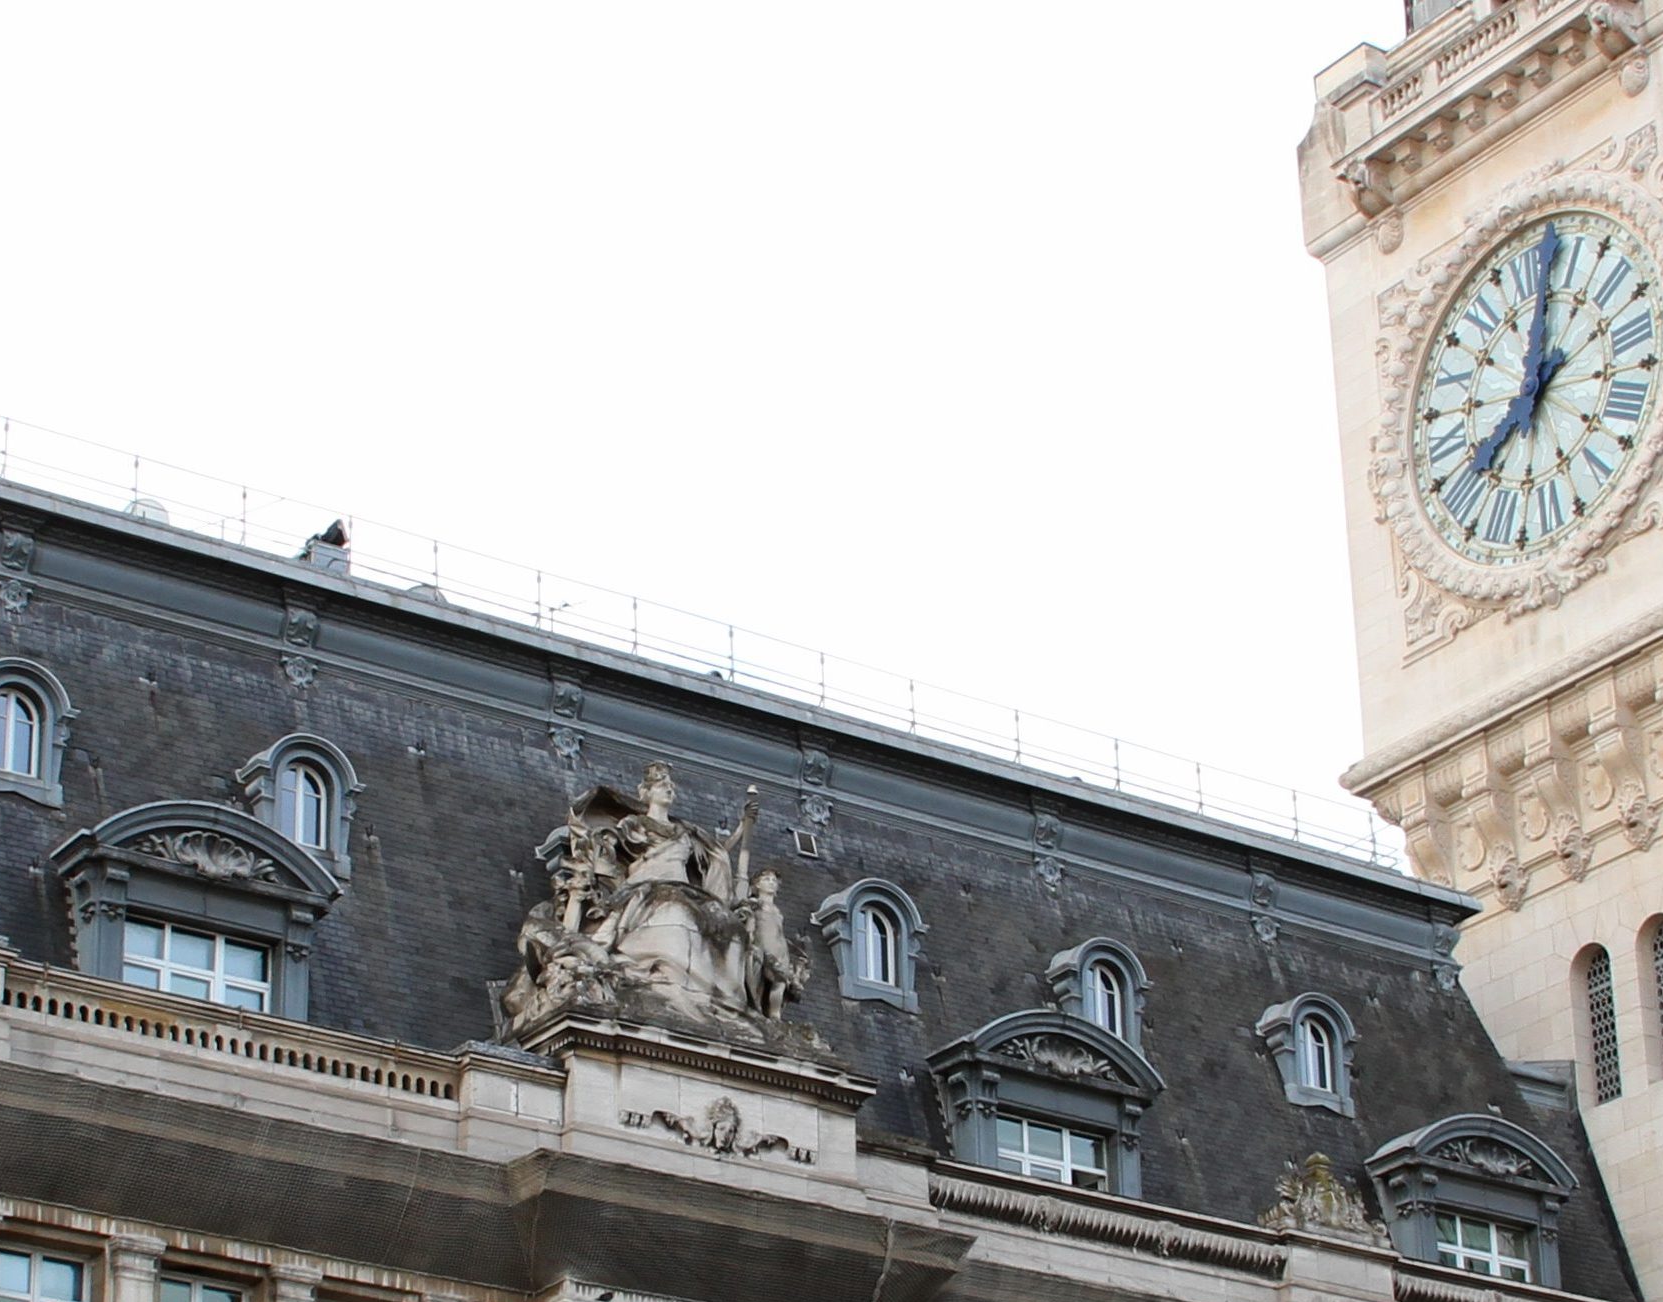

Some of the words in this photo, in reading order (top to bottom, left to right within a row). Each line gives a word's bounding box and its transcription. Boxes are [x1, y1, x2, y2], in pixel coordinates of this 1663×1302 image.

[1593, 256, 1632, 310] II
[1610, 308, 1654, 358] III
[1436, 366, 1475, 394] X
[1601, 380, 1650, 423] IIII
